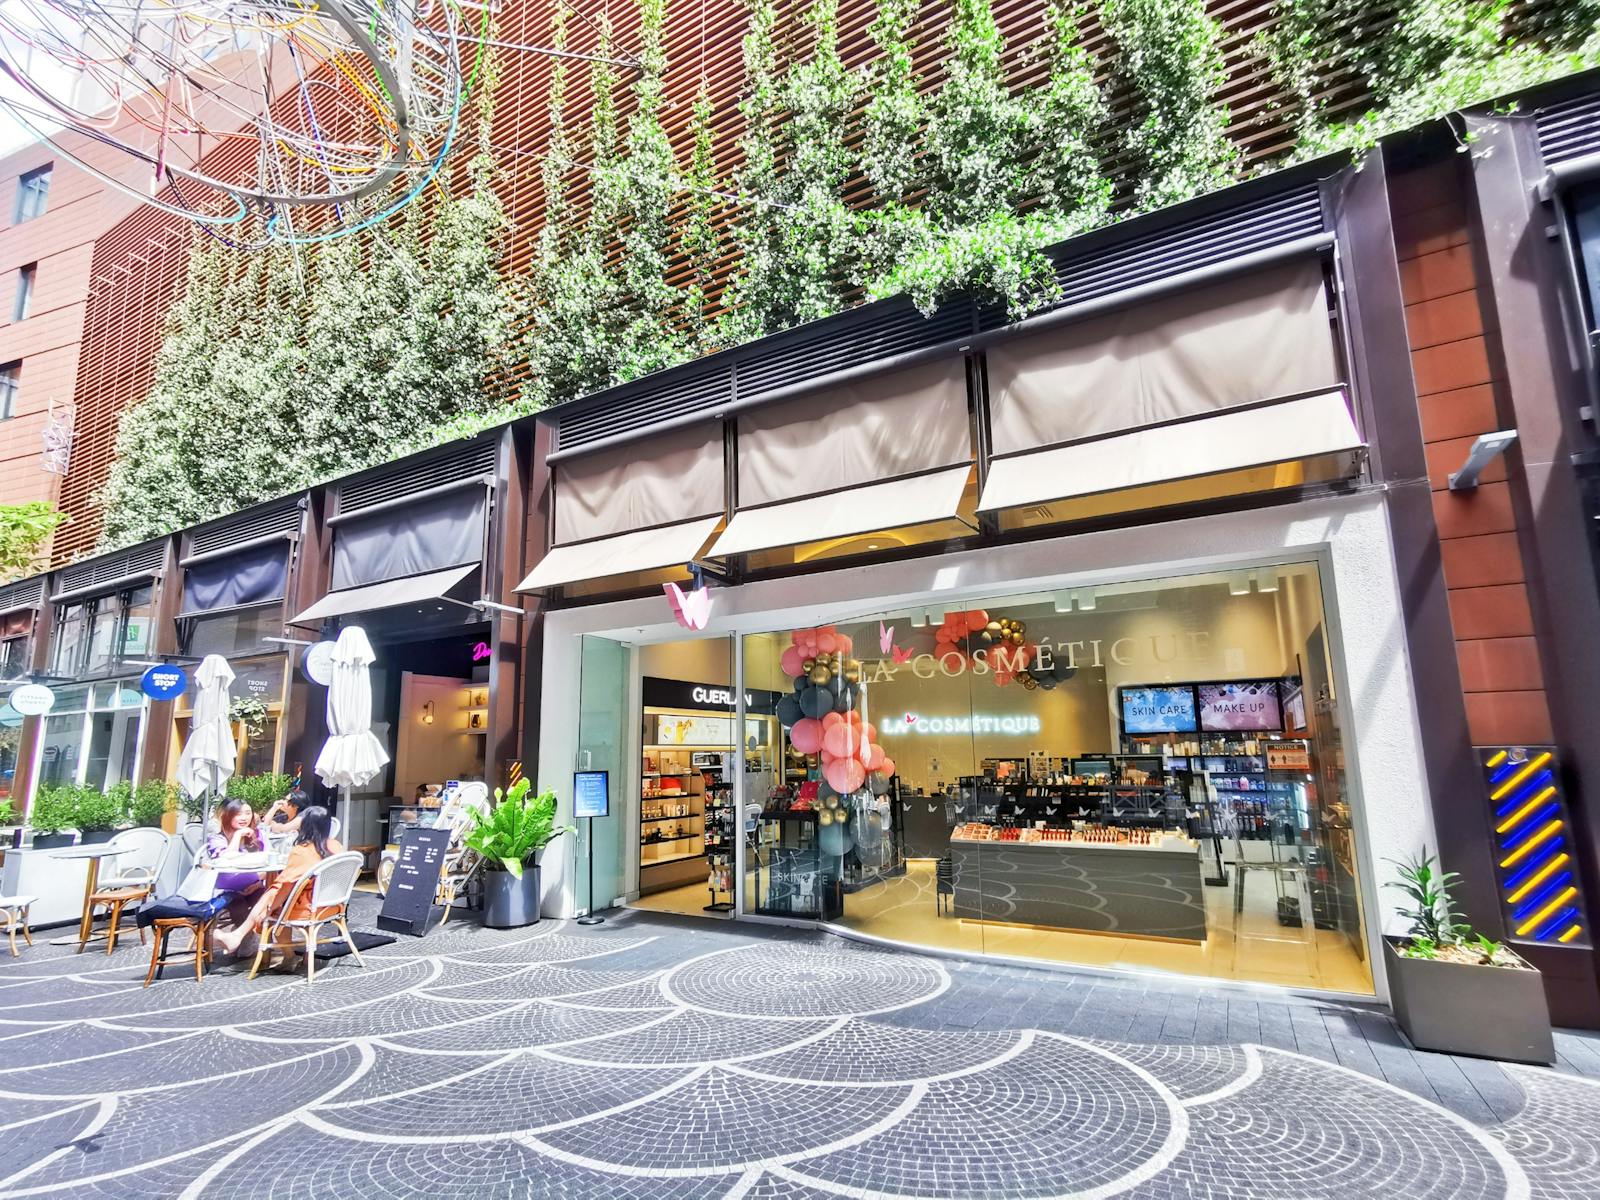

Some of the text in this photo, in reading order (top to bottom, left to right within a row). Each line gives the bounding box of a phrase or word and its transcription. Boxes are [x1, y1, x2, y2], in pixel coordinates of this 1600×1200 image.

[152, 673, 180, 681] SHORT
[856, 659, 898, 684] LA
[1132, 705, 1186, 716] SKIN CARE
[1213, 702, 1265, 714] MAKE UP
[882, 715, 1040, 735] LA COSMÉTIQUE
[777, 872, 801, 883] SKIN
